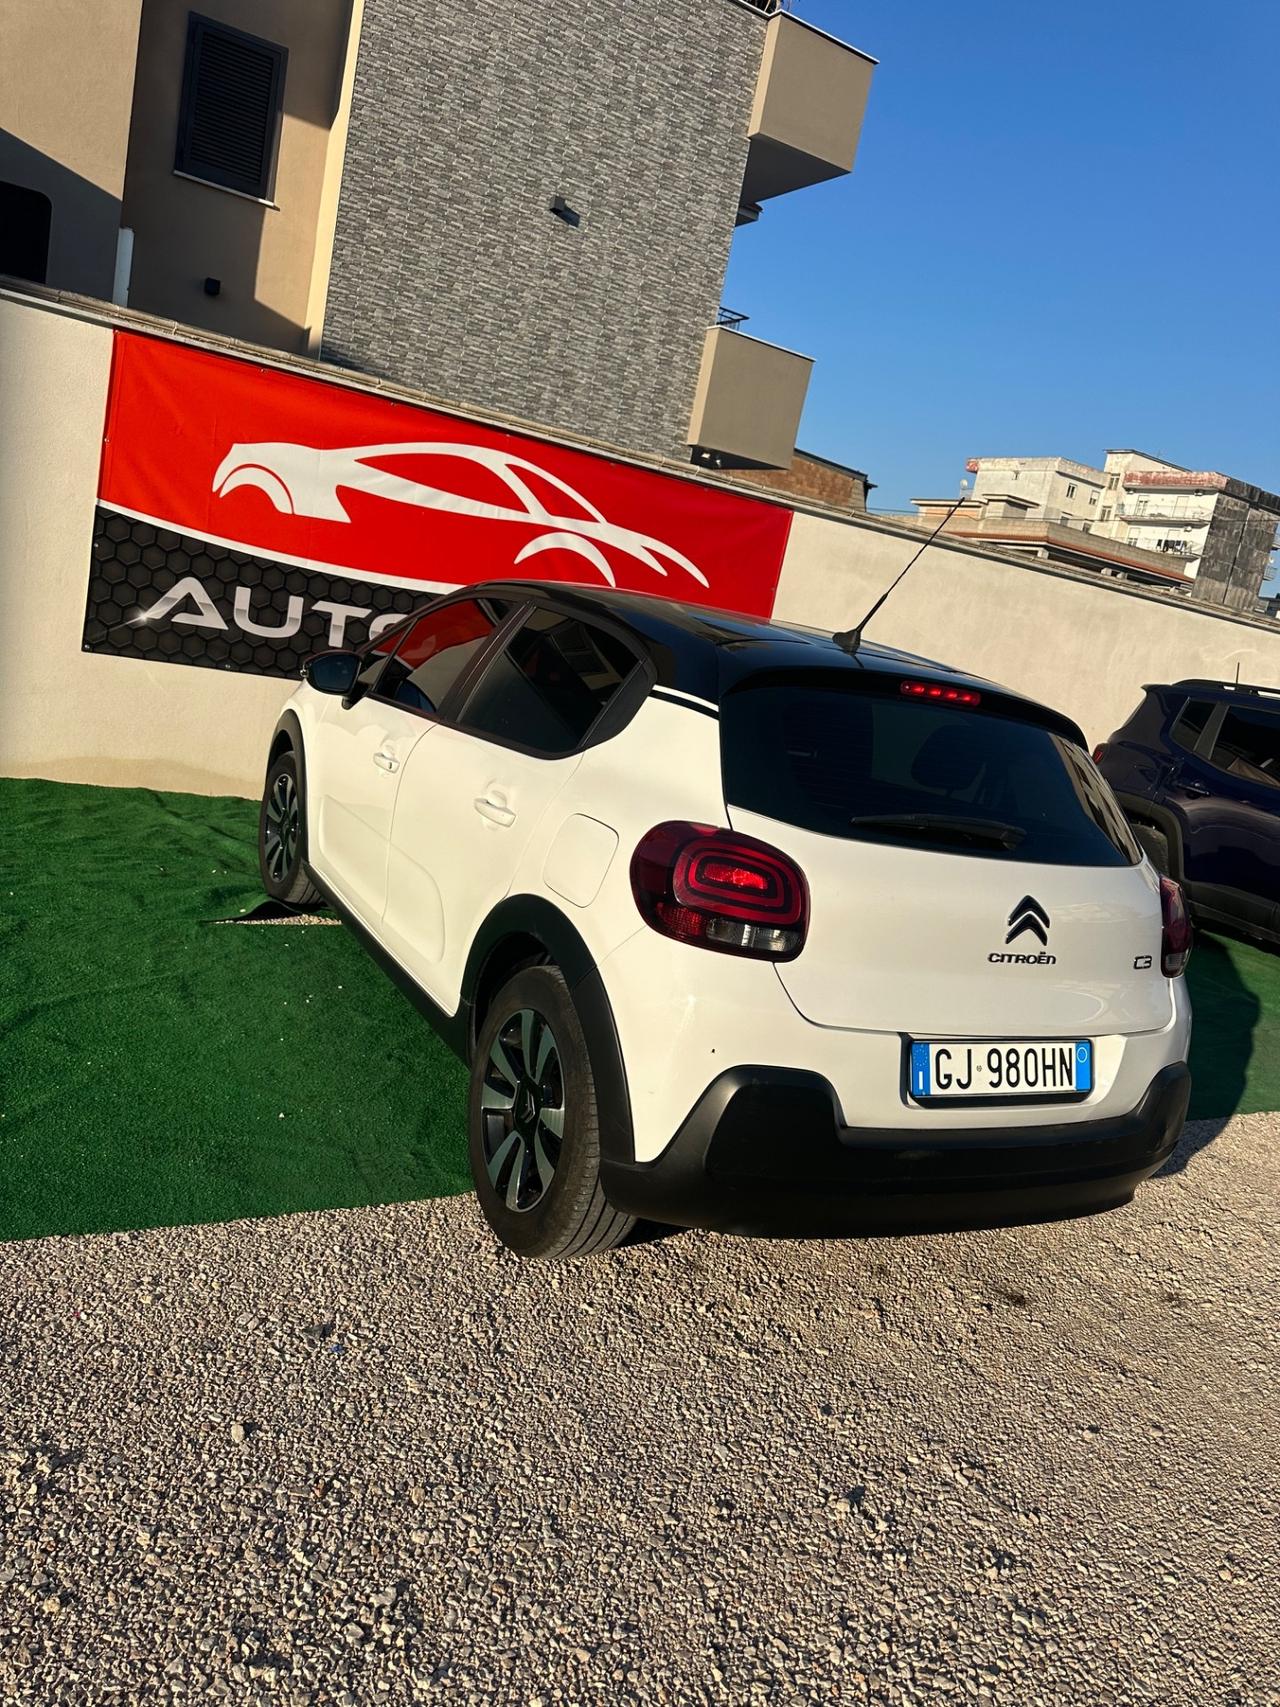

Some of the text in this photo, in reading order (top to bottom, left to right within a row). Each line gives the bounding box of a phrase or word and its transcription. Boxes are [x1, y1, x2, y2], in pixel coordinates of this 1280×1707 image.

[1133, 955, 1152, 970] C3
[935, 1047, 1073, 1090] GJ 980HN
